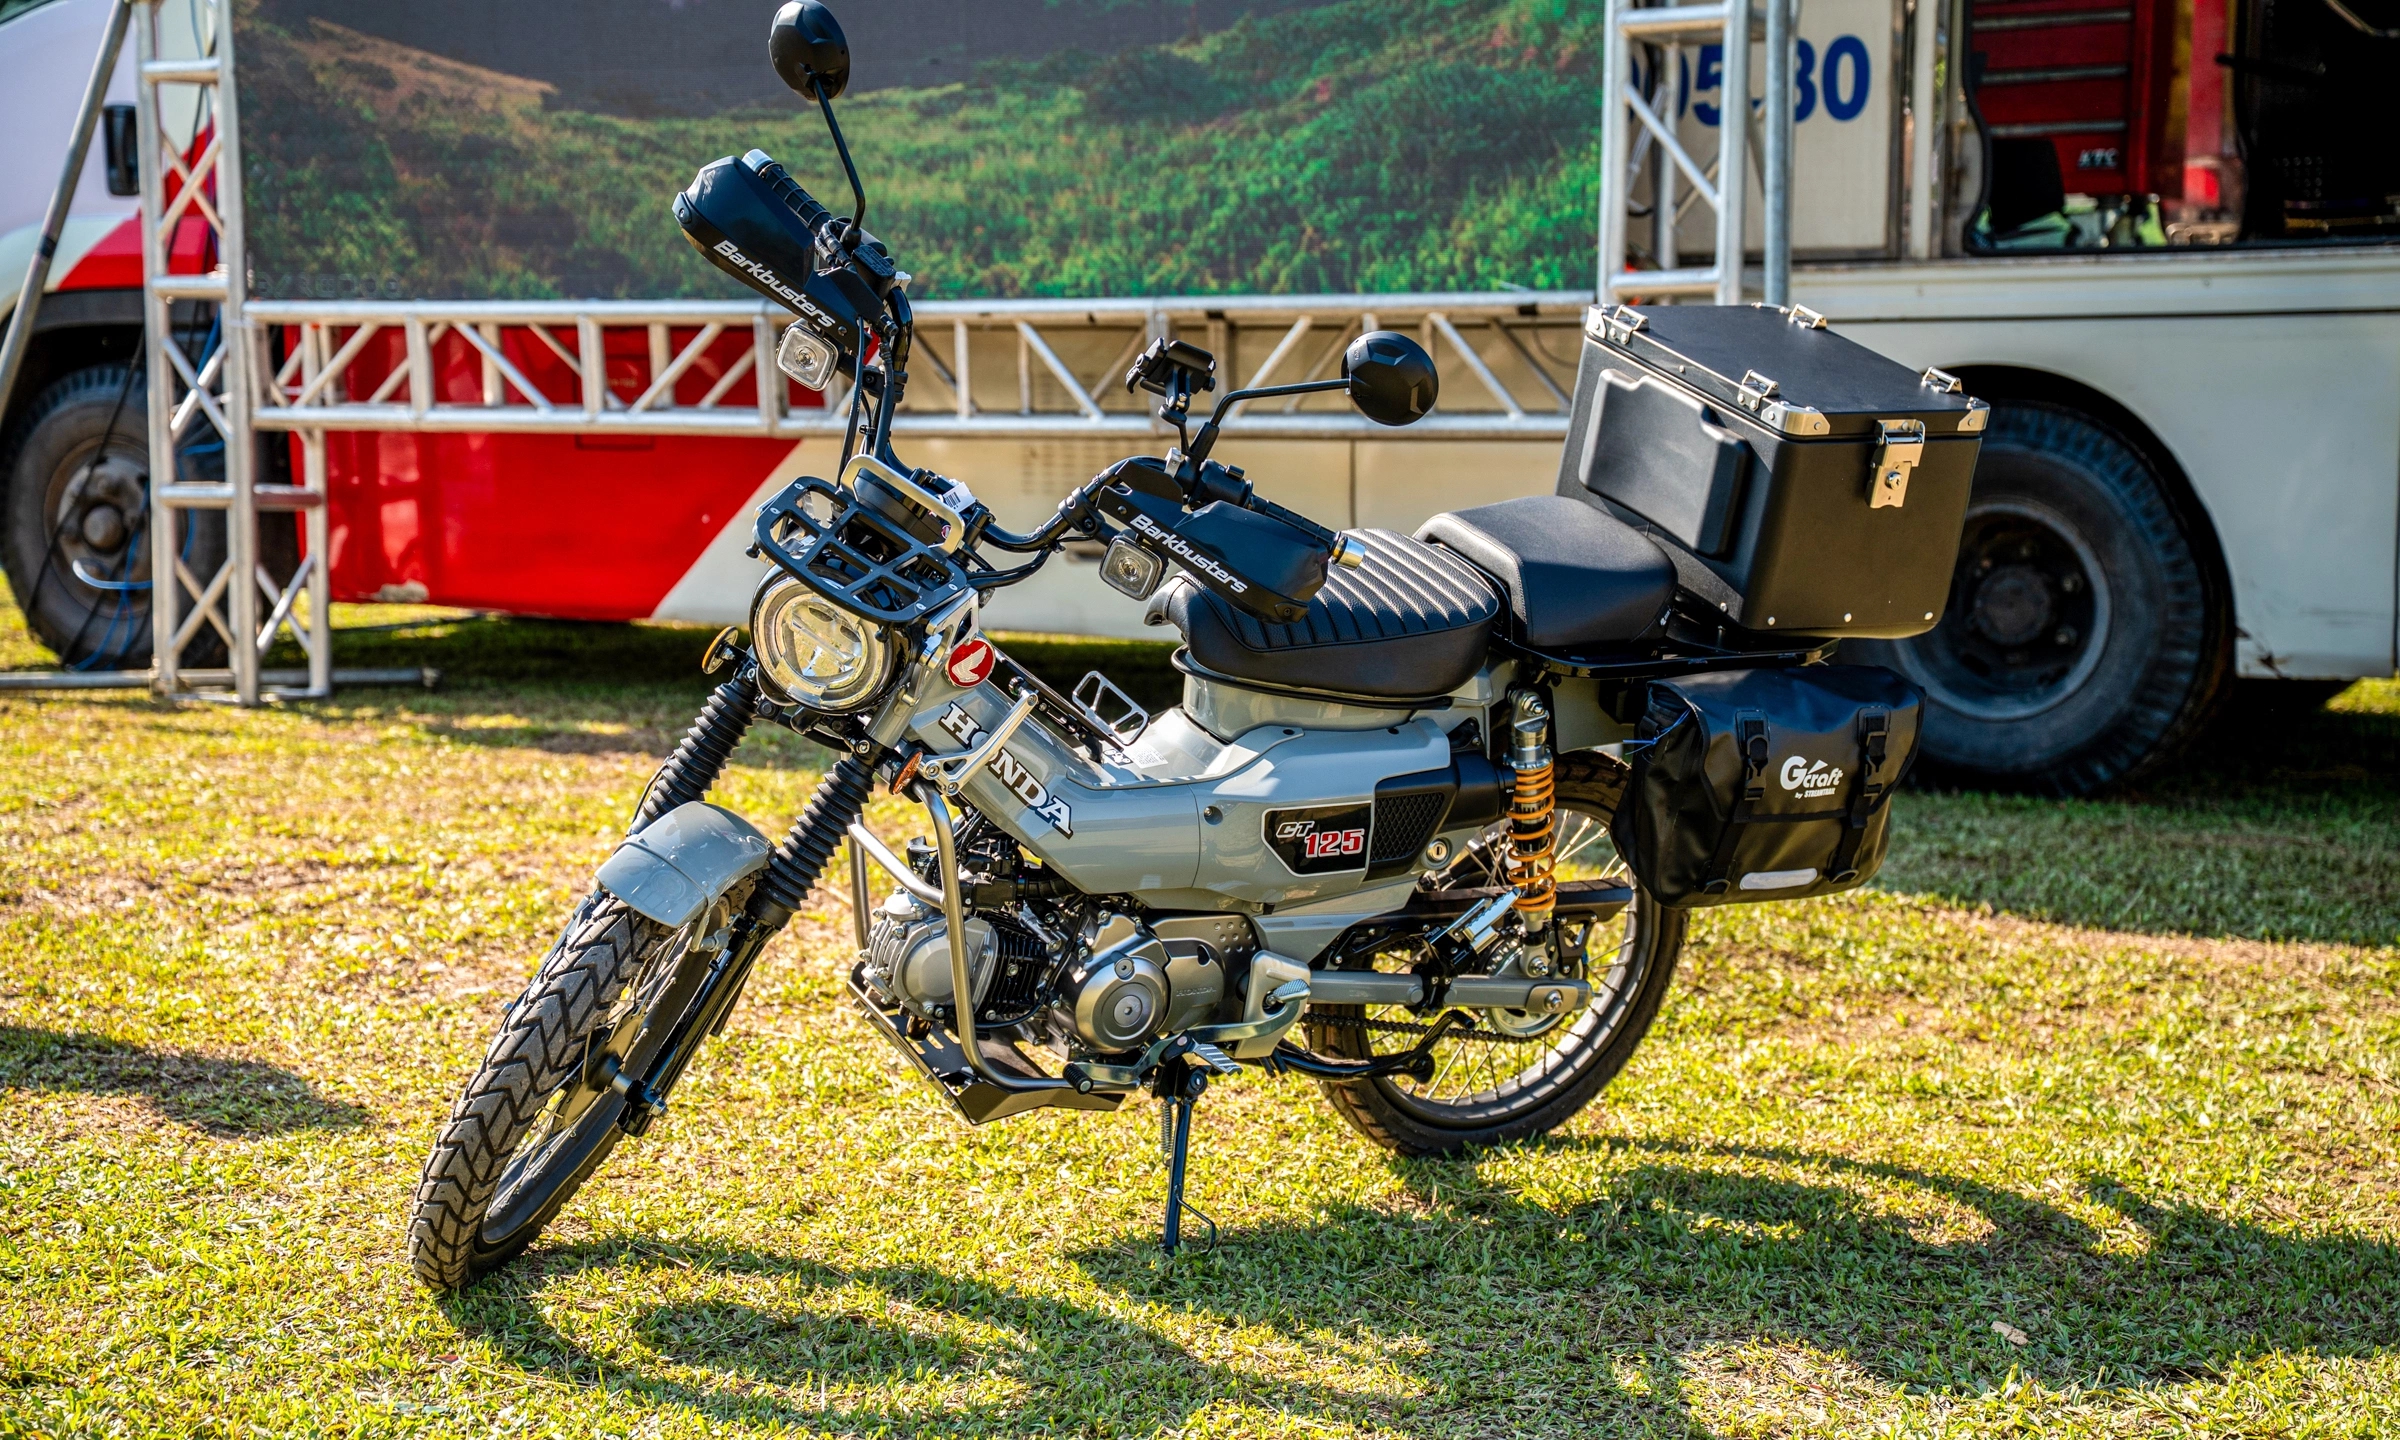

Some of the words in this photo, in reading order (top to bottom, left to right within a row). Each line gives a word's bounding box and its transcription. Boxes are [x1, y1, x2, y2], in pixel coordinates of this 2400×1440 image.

[713, 240, 836, 328] Barkbusters
[1130, 513, 1248, 594] Barkbusters
[1276, 821, 1315, 838] CT
[1304, 828, 1365, 859] 125
